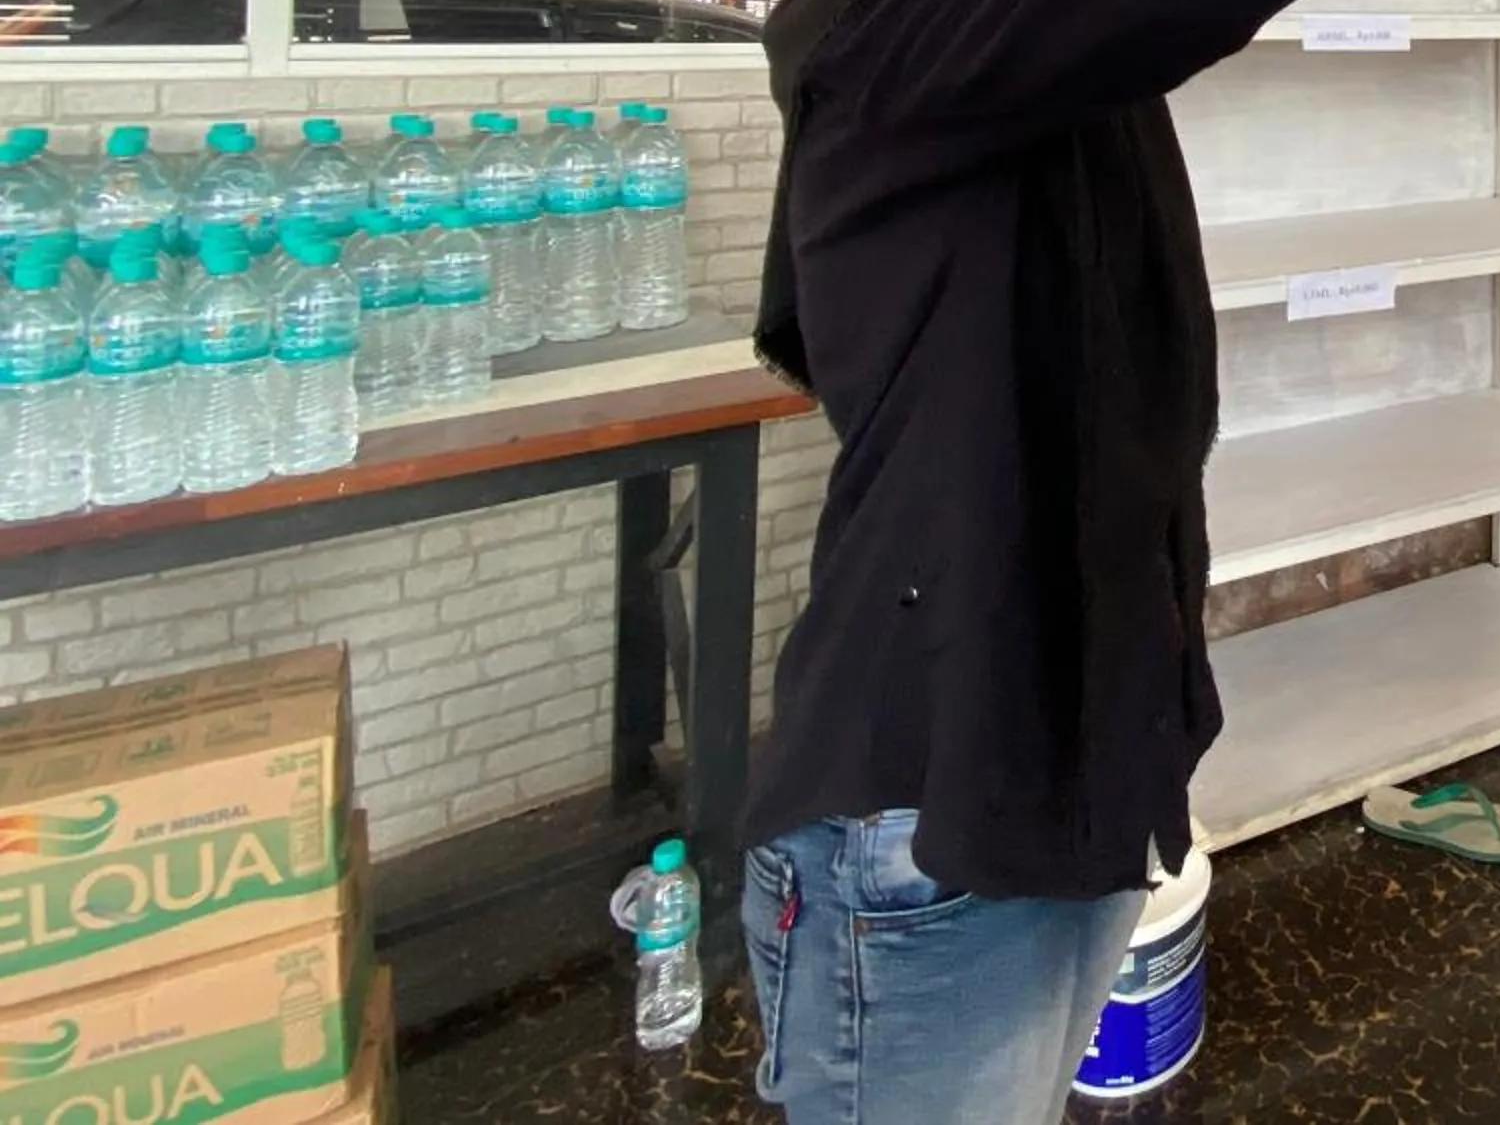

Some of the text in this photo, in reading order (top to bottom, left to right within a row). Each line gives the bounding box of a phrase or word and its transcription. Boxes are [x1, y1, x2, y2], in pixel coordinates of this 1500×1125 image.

[133, 804, 250, 842] AIR MINERAL
[9, 1063, 224, 1125] QUA
